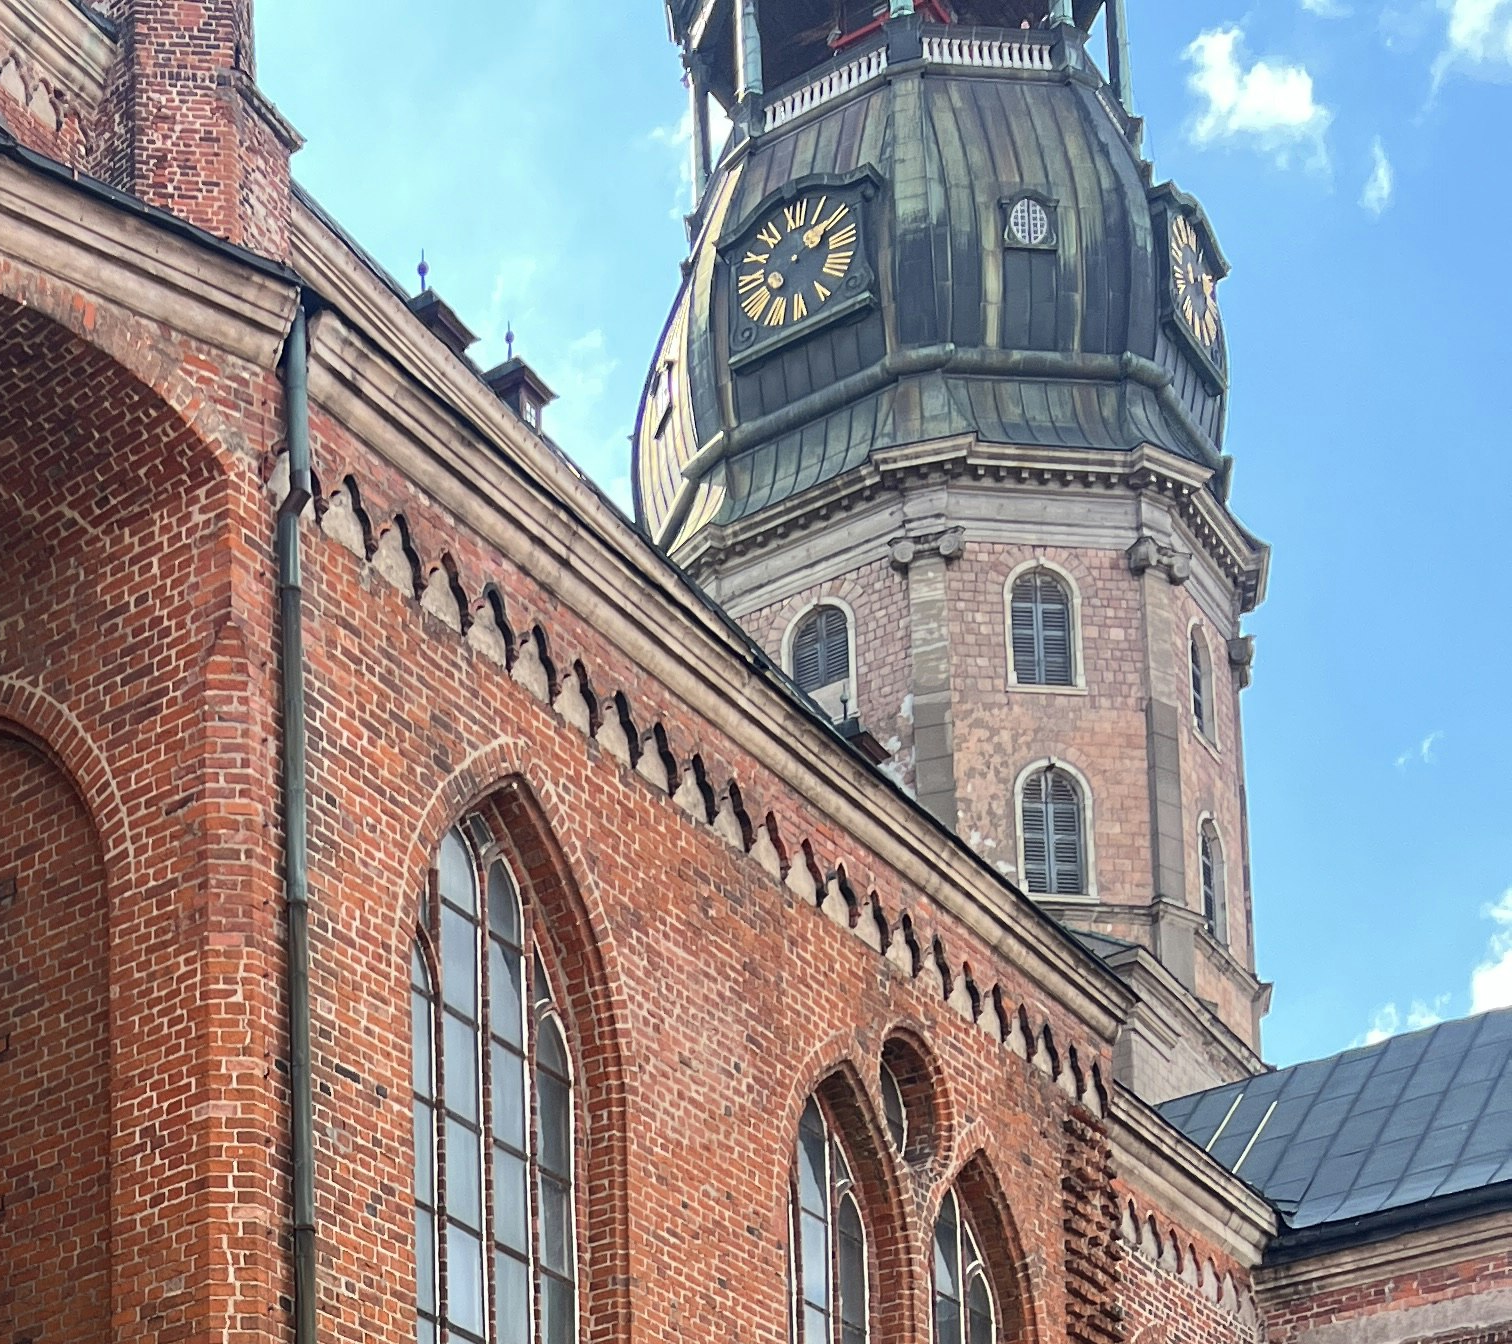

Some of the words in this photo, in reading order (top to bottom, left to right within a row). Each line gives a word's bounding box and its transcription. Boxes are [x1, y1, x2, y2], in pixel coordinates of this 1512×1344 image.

[784, 198, 807, 232] XII
[757, 222, 781, 248] XI
[829, 223, 856, 249] III
[743, 252, 769, 263] X
[823, 251, 853, 277] IIII
[738, 269, 764, 294] IX
[813, 281, 831, 301] V
[741, 286, 770, 321] VIII
[764, 297, 787, 326] VII
[794, 291, 807, 321] VI
